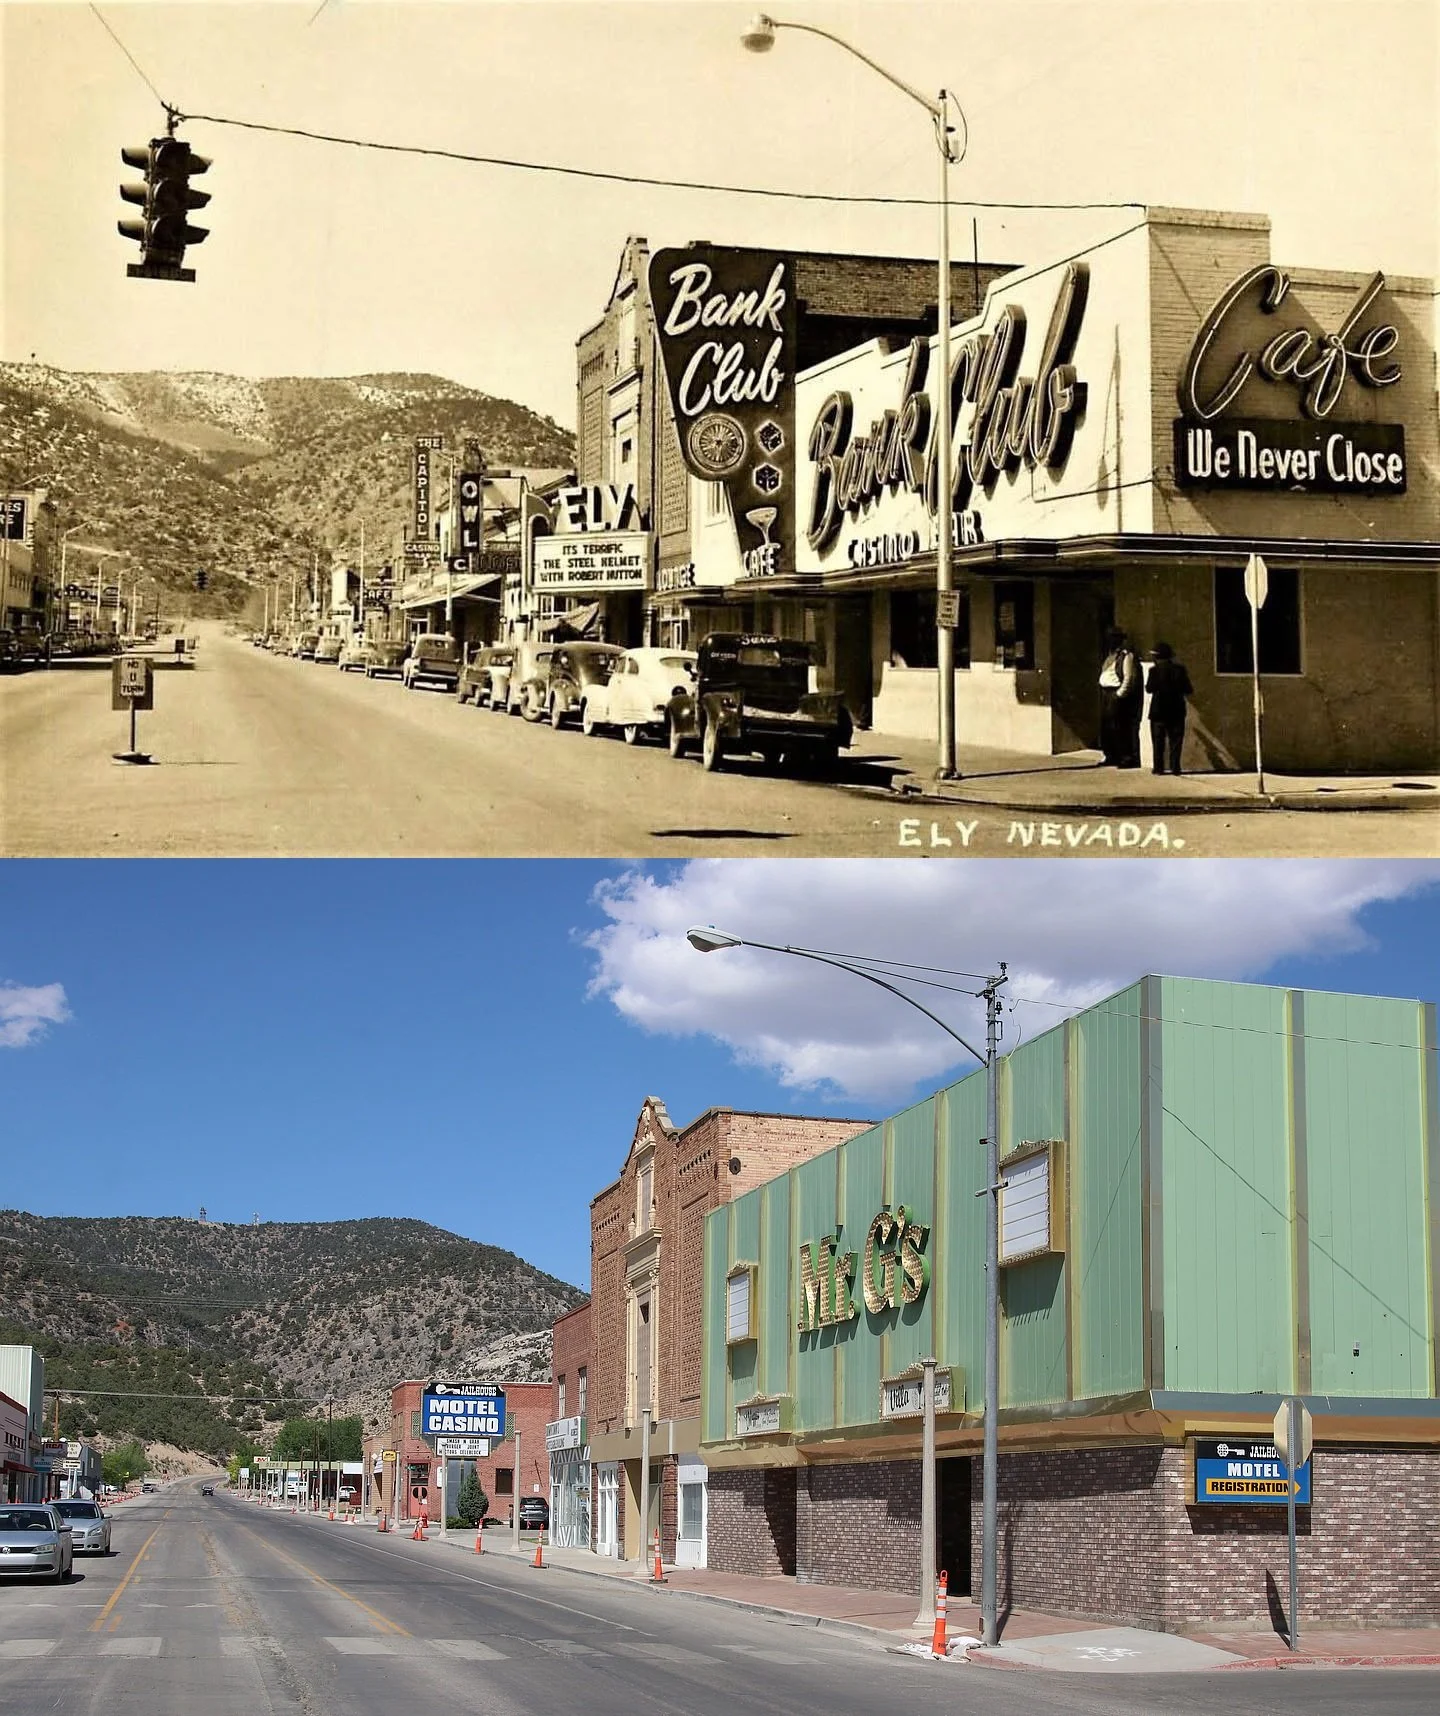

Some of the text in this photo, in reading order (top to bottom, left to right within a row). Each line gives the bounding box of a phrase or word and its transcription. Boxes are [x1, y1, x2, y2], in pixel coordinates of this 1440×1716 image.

[664, 262, 786, 337] Bank
[1177, 263, 1402, 421] Cafe
[679, 337, 785, 416] Club
[805, 262, 1090, 551] Bank Club
[417, 438, 440, 448] THE
[1187, 428, 1403, 484] We Never Close
[417, 453, 428, 536] CAPITOL
[461, 480, 479, 548] OWL
[557, 484, 635, 533] ELY
[405, 544, 440, 553] CASINO
[562, 543, 623, 555] ITS TERRIFIC
[848, 531, 920, 567] CASINO
[543, 555, 640, 569] THE STEEL HELMET
[743, 546, 776, 578] CAFE
[540, 568, 643, 582] WITH ROBERT HUTTON
[123, 685, 144, 693] TURN
[460, 1384, 497, 1397] JAILHOUSE
[429, 1399, 499, 1415] MOTEL
[428, 1415, 499, 1433] CASINO
[1249, 1446, 1280, 1458] JAILHO
[1227, 1463, 1281, 1478] MOTEL
[1211, 1481, 1289, 1493] REGISTRATION
